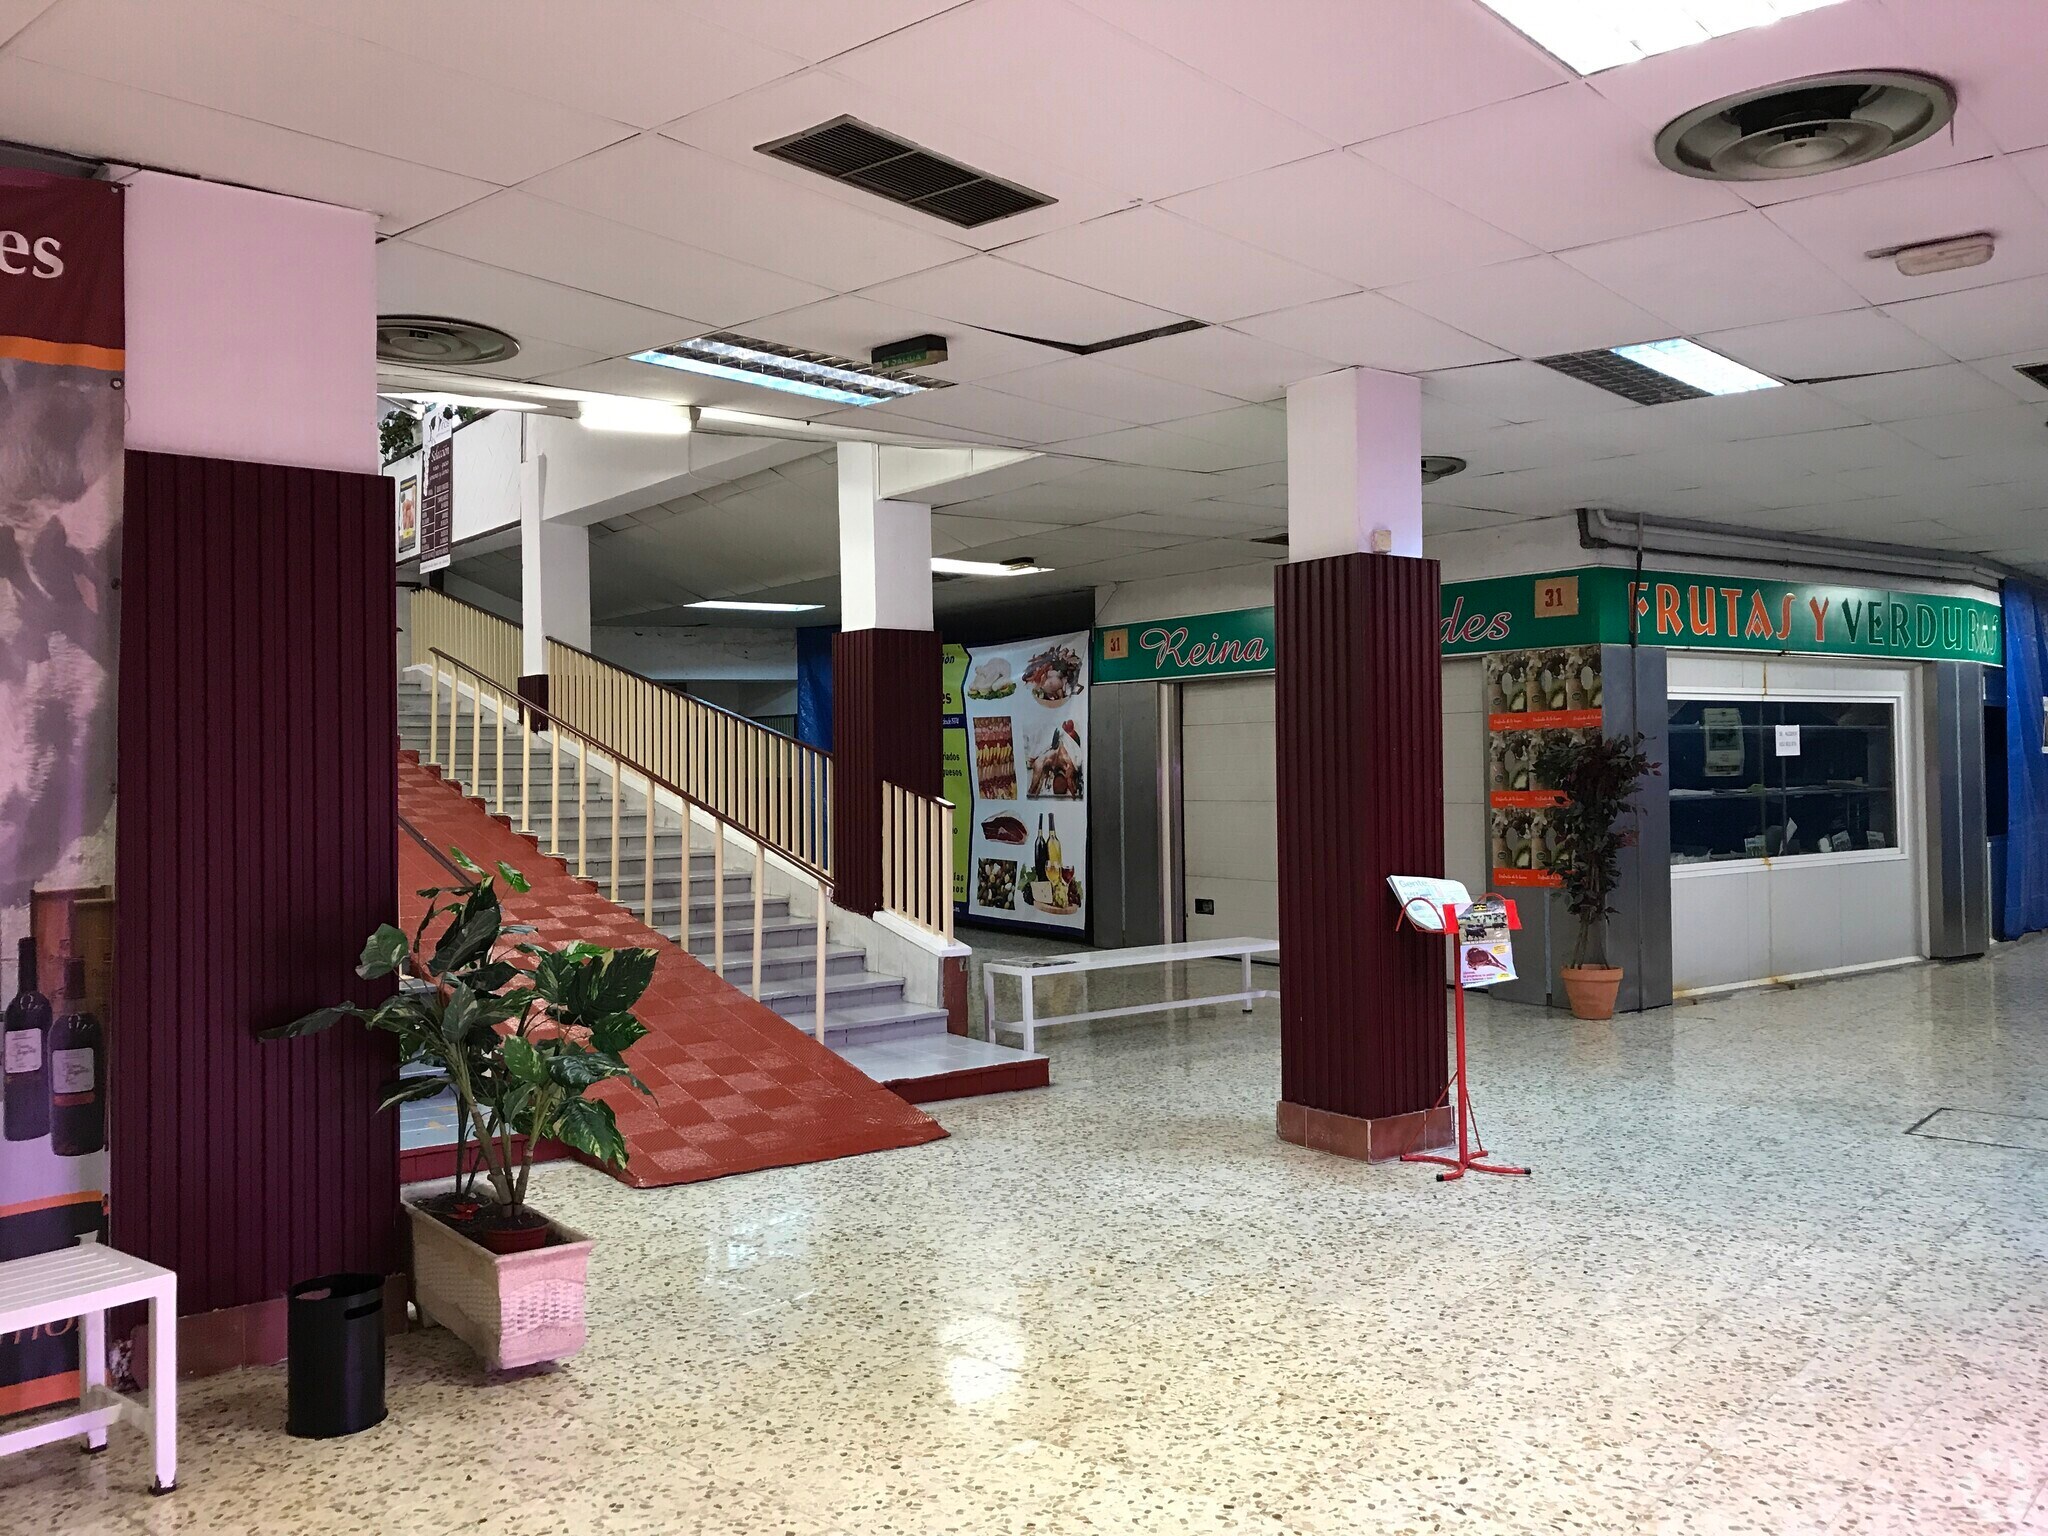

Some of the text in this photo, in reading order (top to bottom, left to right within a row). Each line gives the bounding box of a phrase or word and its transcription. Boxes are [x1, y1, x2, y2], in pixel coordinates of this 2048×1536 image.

[1544, 587, 1564, 608] 31
[1627, 581, 1999, 656] FRUTAS Y VERDURAS
[1110, 637, 1121, 652] 31
[1139, 626, 1269, 670] Reina
